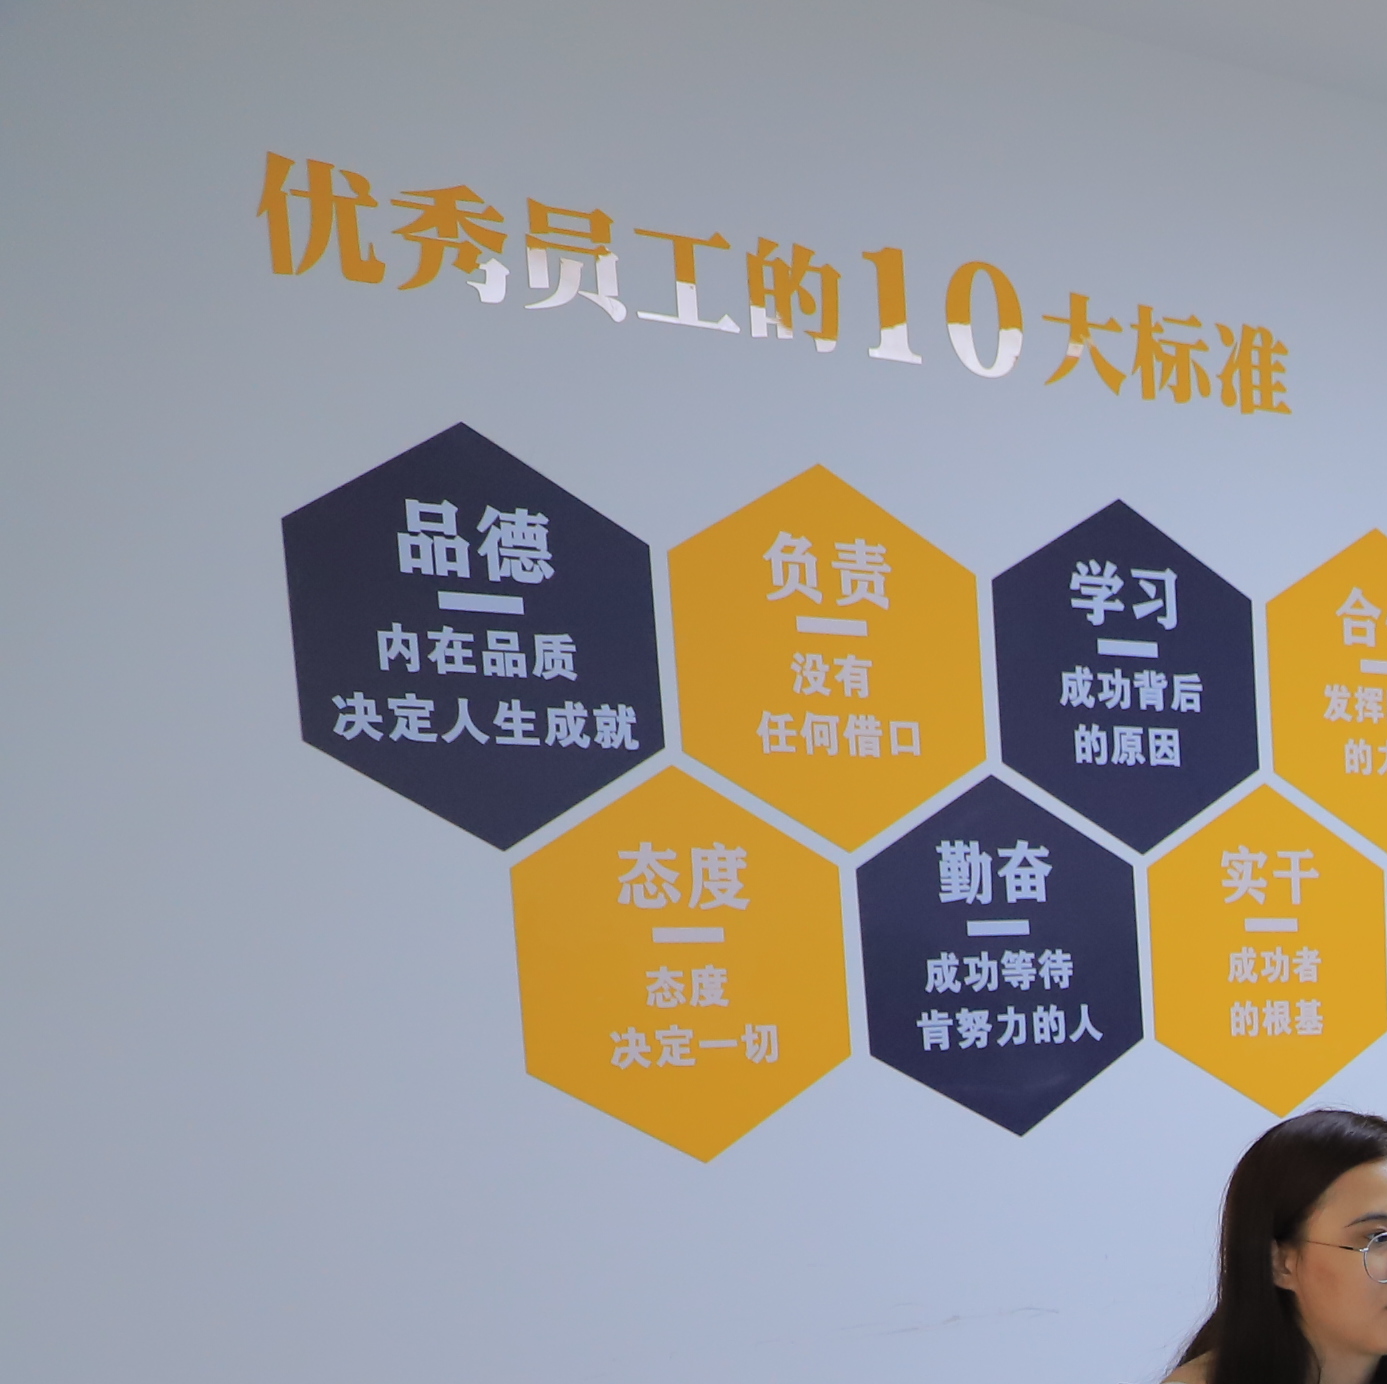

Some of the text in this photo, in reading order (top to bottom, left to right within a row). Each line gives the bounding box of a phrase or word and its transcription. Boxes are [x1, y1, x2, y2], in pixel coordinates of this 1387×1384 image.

[255, 150, 1293, 415] 优秀员工的10大标准
[397, 498, 555, 585] 品德
[763, 531, 893, 610] 负责
[1070, 559, 1178, 630] 学习
[376, 622, 579, 682] 内在品质
[791, 653, 873, 699] 没有
[1060, 664, 1204, 713] 成功背后
[332, 692, 640, 751] 决定人生成就
[757, 711, 922, 758] 任何借口
[1072, 721, 1183, 769] 的原因
[617, 841, 750, 912] 态度
[935, 839, 1053, 905] 勤奋
[1220, 845, 1320, 905] 实干
[645, 965, 730, 1009] 态度
[923, 949, 1075, 995] 成功等待
[1228, 946, 1322, 984] 成功者
[916, 1004, 1104, 1052] 肯努力的人
[1229, 1000, 1324, 1037] 的根基
[610, 1023, 780, 1070] 决定一切
